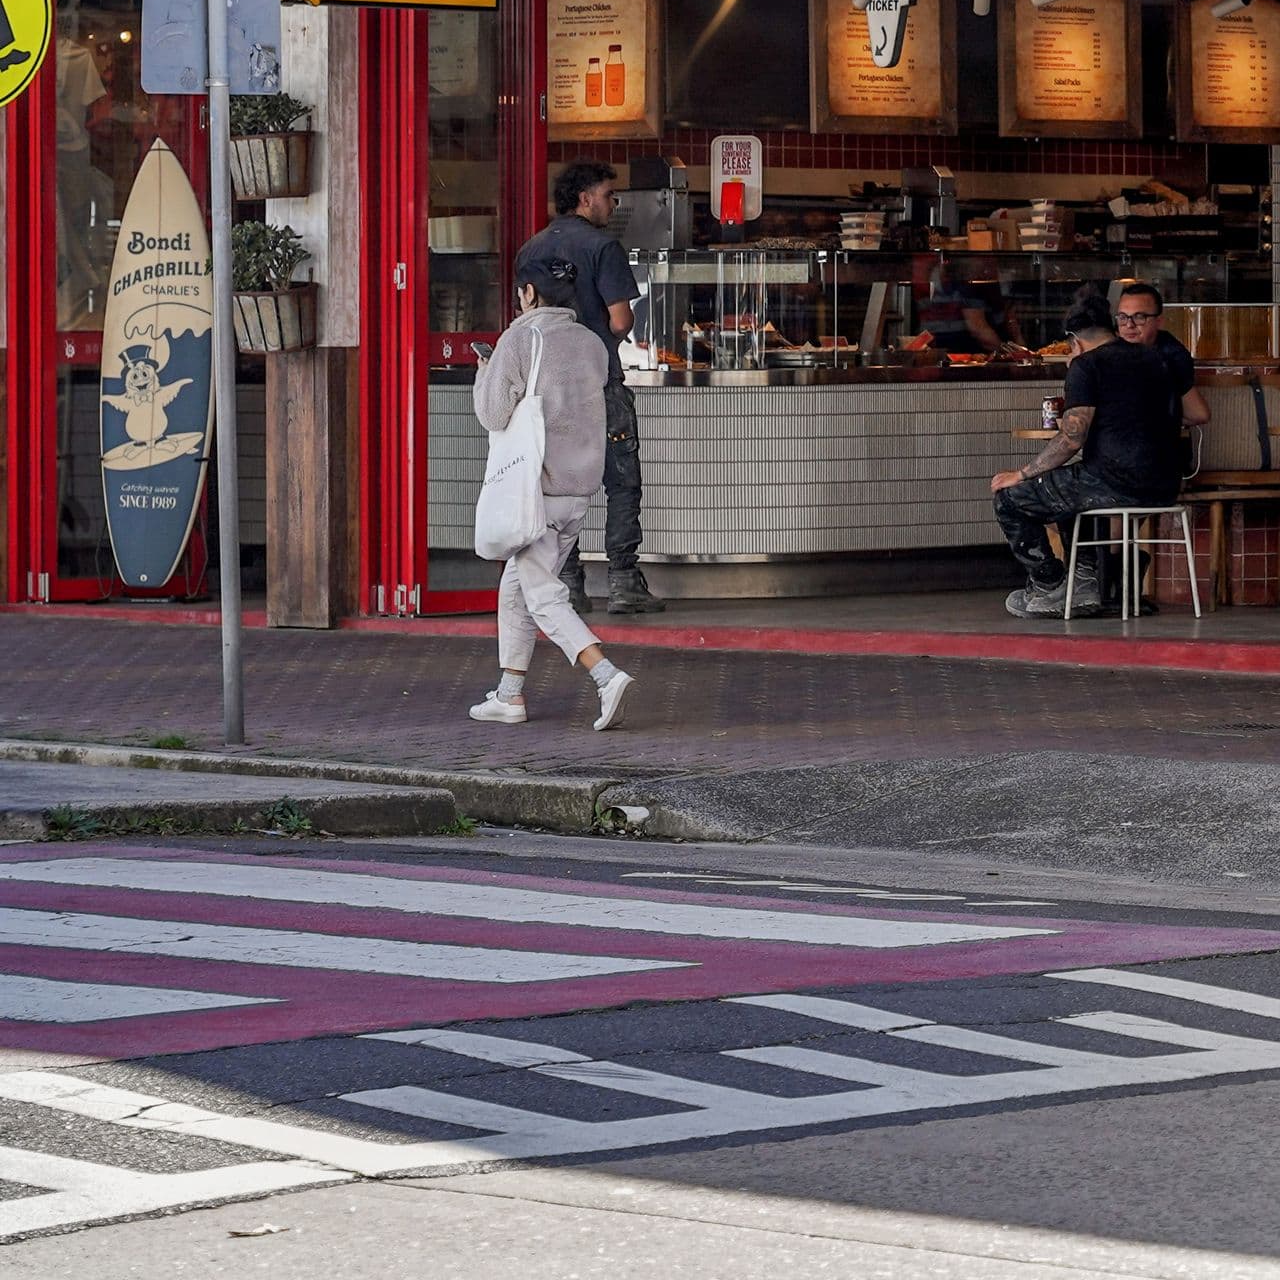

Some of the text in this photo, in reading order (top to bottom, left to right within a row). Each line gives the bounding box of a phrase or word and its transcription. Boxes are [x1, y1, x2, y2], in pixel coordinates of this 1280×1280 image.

[868, 0, 899, 12] TICKET
[721, 141, 752, 151] FOR YOUR
[722, 157, 752, 169] PLEASE
[127, 231, 191, 255] Bondi
[113, 261, 203, 297] CHARGRILL
[142, 284, 200, 297] CHARLIE'S
[121, 483, 179, 495] Catching waves
[119, 495, 177, 509] SINCE 1989
